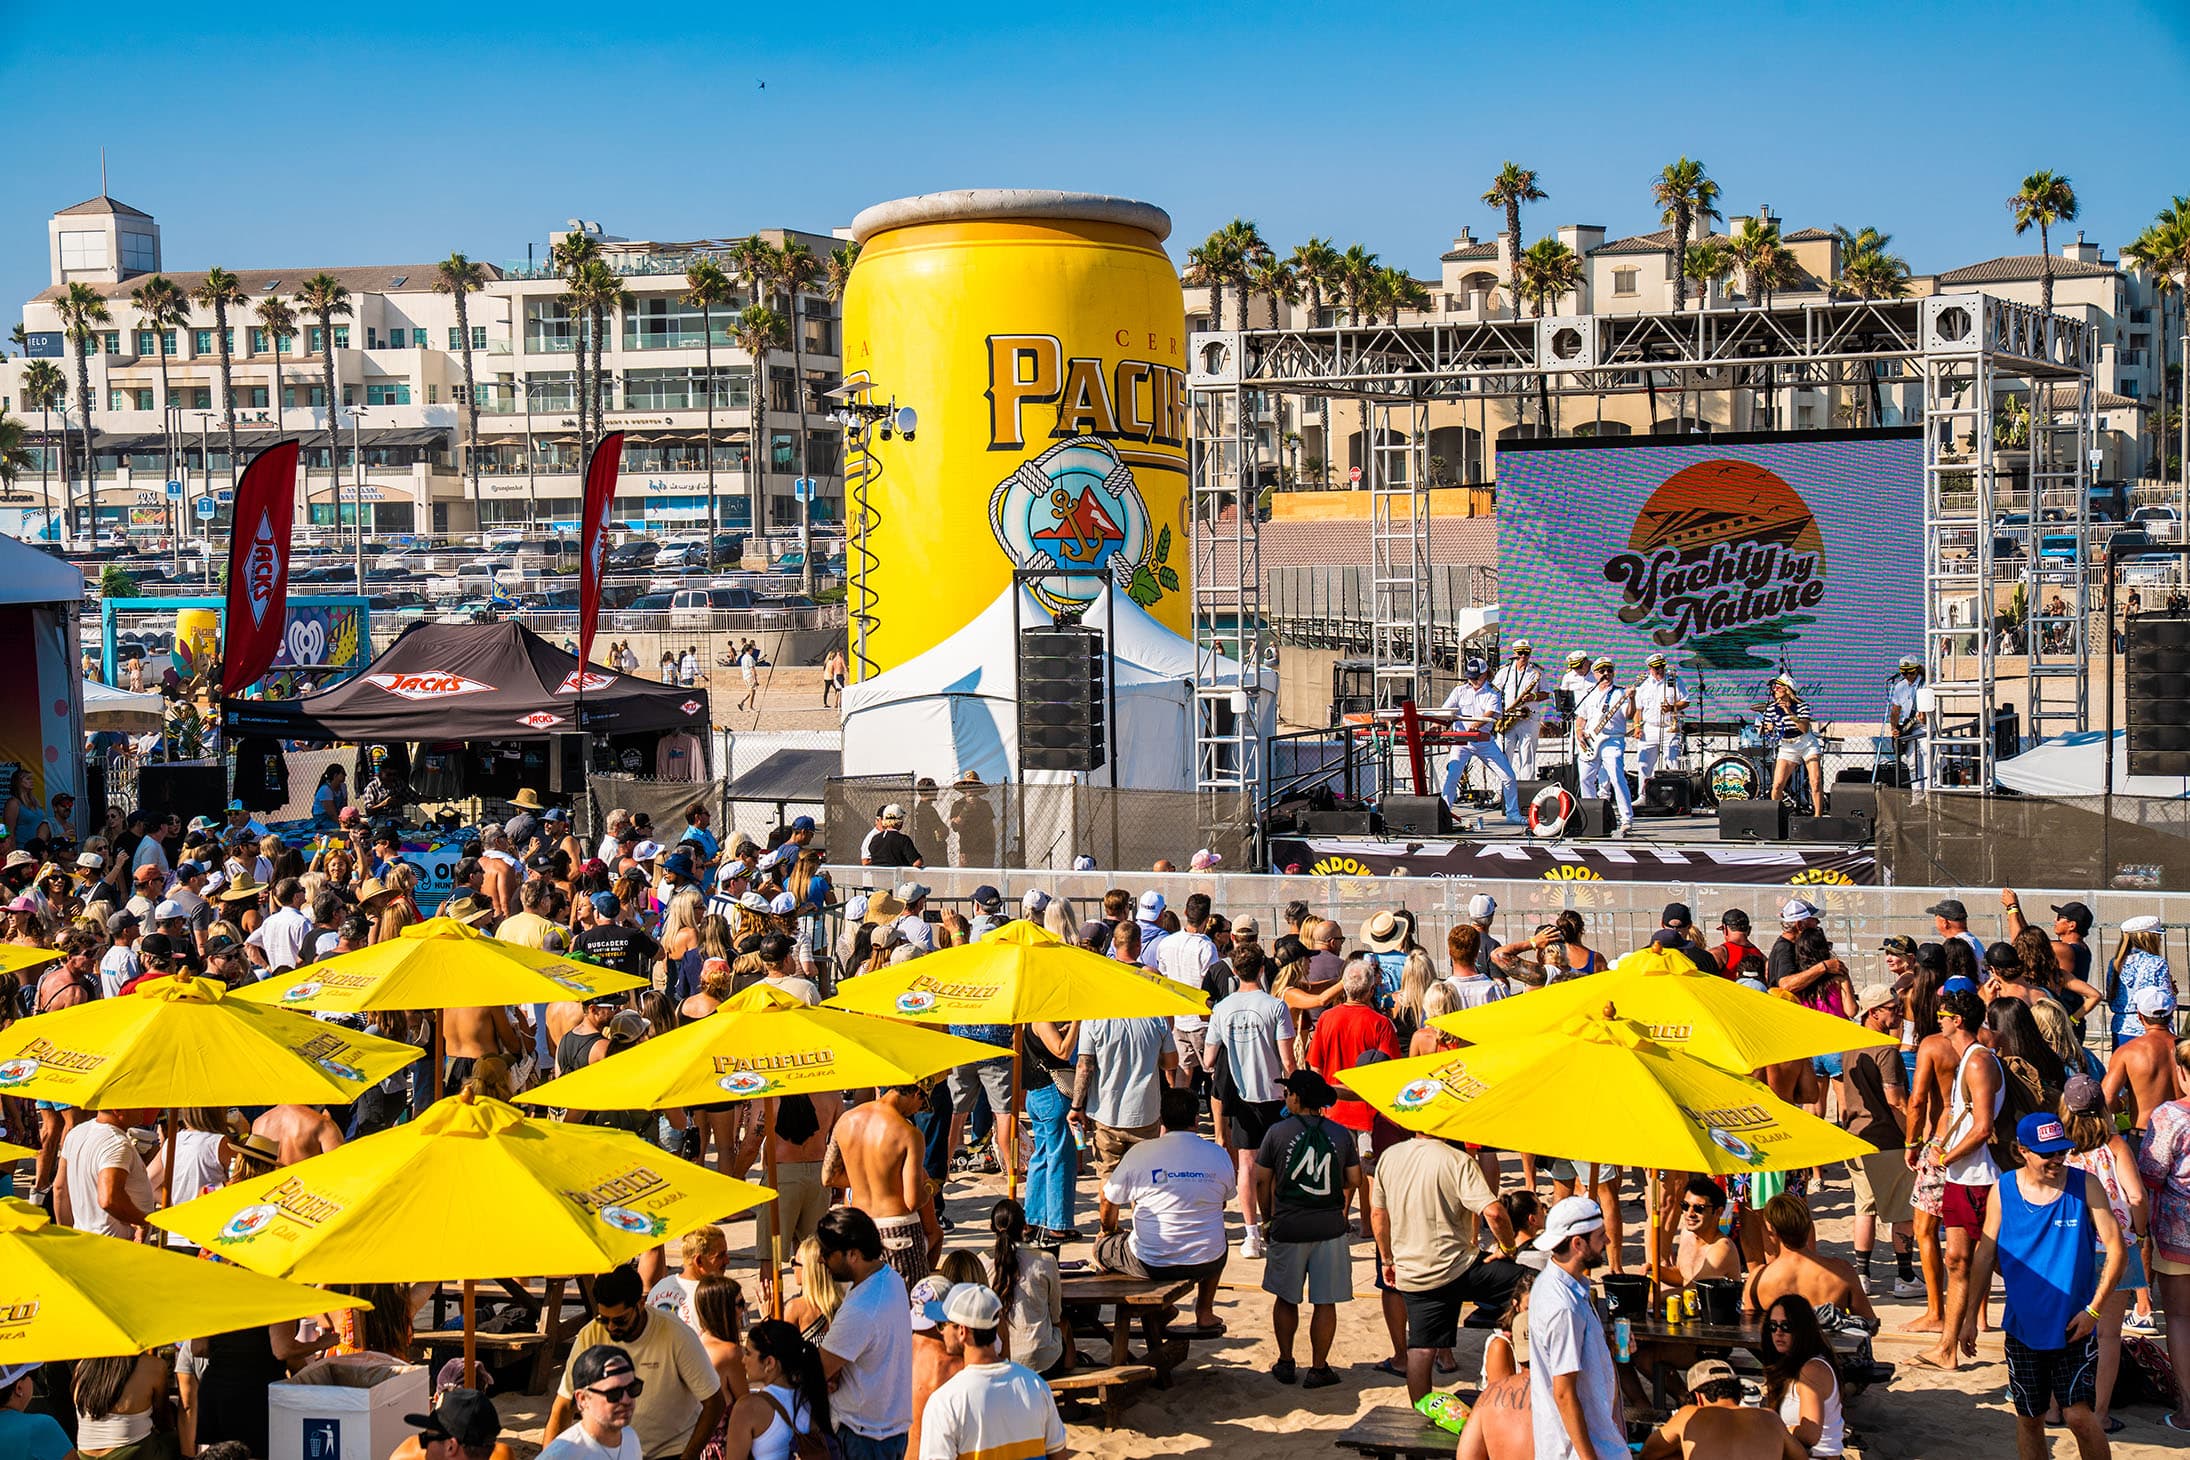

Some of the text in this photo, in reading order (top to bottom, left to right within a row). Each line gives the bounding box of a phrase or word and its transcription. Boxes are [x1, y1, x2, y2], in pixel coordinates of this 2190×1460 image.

[1115, 328, 1185, 355] CER
[1603, 546, 1816, 624] Yachty by
[1652, 579, 1824, 646] Nature
[587, 940, 629, 950] BUSCADERO
[1648, 1024, 1692, 1039] ICO
[713, 1048, 835, 1074] PACIFICO
